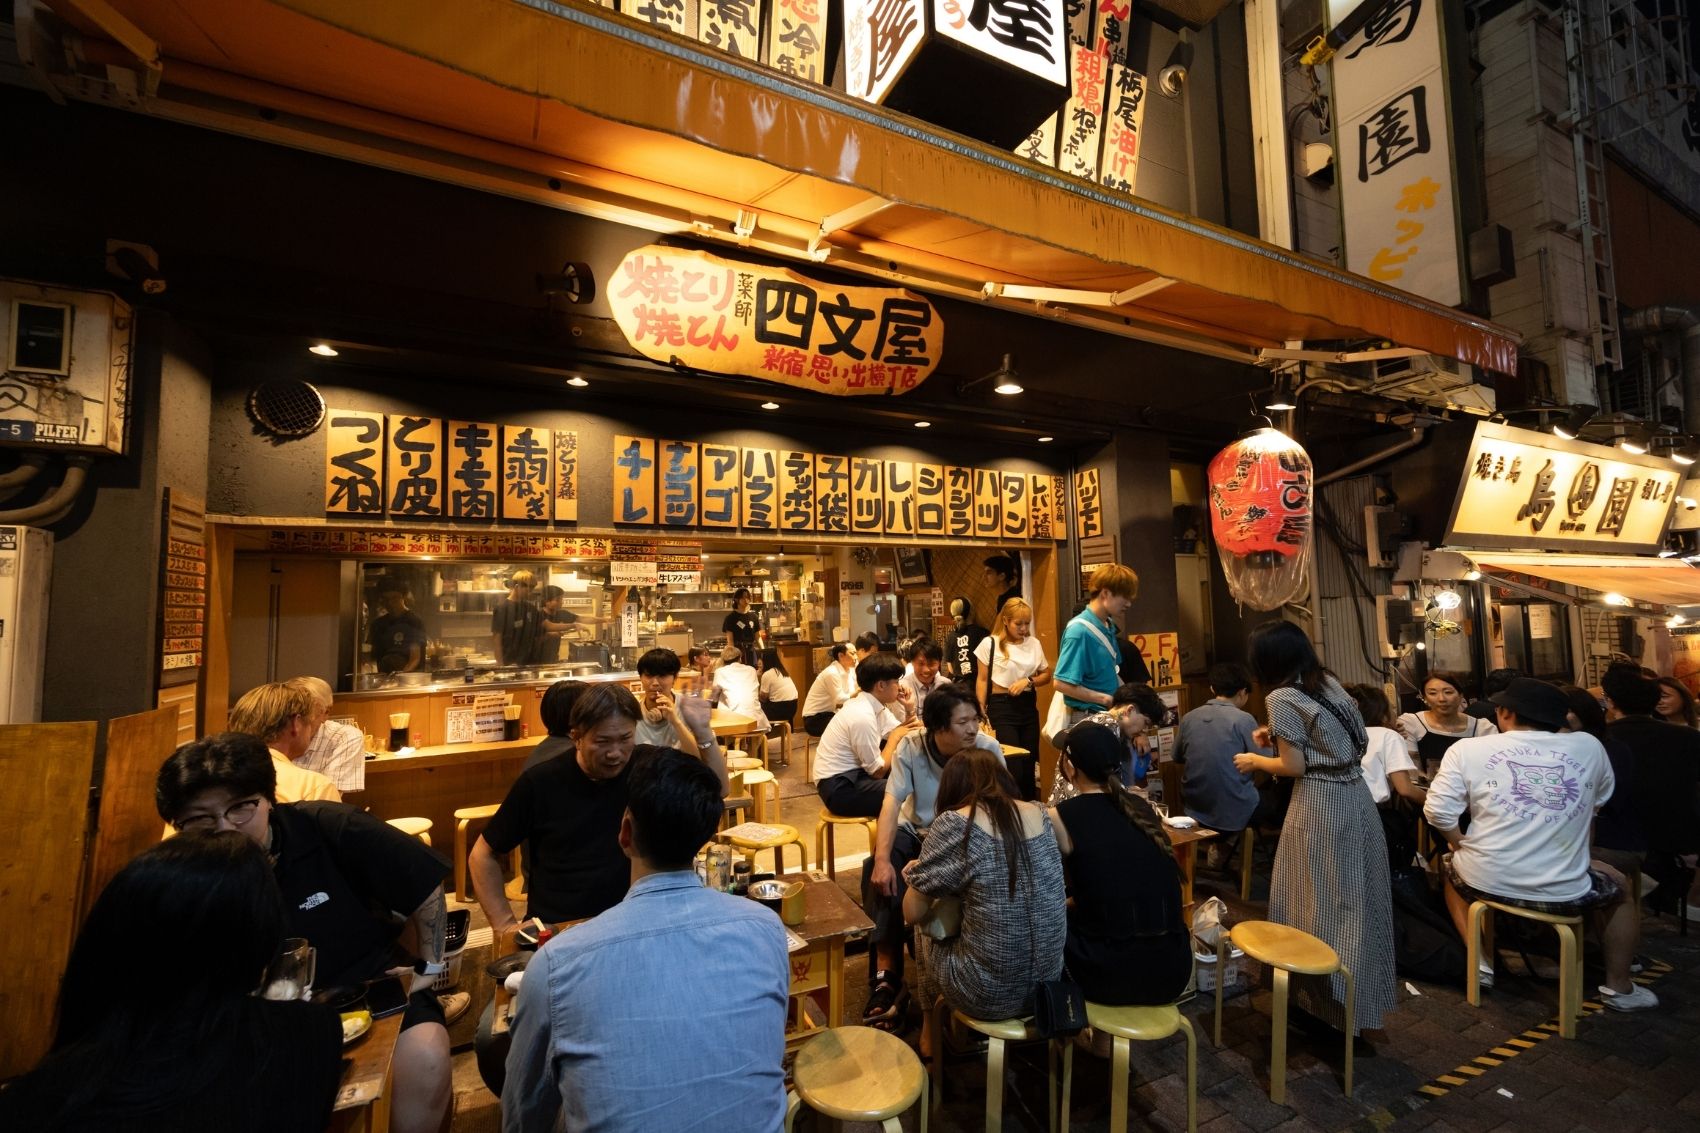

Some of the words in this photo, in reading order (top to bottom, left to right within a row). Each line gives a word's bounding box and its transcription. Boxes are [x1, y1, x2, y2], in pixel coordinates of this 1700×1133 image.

[618, 255, 734, 311] 焼とり
[734, 272, 754, 326] 薬師
[634, 303, 739, 352] 焼とん
[755, 278, 933, 366] 四文屋
[35, 423, 78, 438] PILFER
[330, 417, 381, 512] つくね
[390, 417, 440, 514] とり皮
[452, 424, 495, 517] もも肉
[618, 440, 652, 521] チレ
[665, 442, 696, 525] ナンコツ
[705, 448, 739, 522] アゴ
[744, 450, 775, 528] ハラミ
[818, 457, 848, 530] 子袋
[854, 460, 881, 529] ガツ
[887, 463, 914, 531] レバ
[918, 468, 943, 530] シロ
[949, 468, 972, 535] カシラ
[976, 470, 999, 531] ハツ
[1003, 476, 1026, 535] タン
[1077, 471, 1099, 537] ハツモト
[1486, 780, 1498, 788] 19
[1550, 750, 1586, 777] TIGER
[1491, 793, 1537, 821] SPIRIT
[1545, 815, 1560, 824] OF
